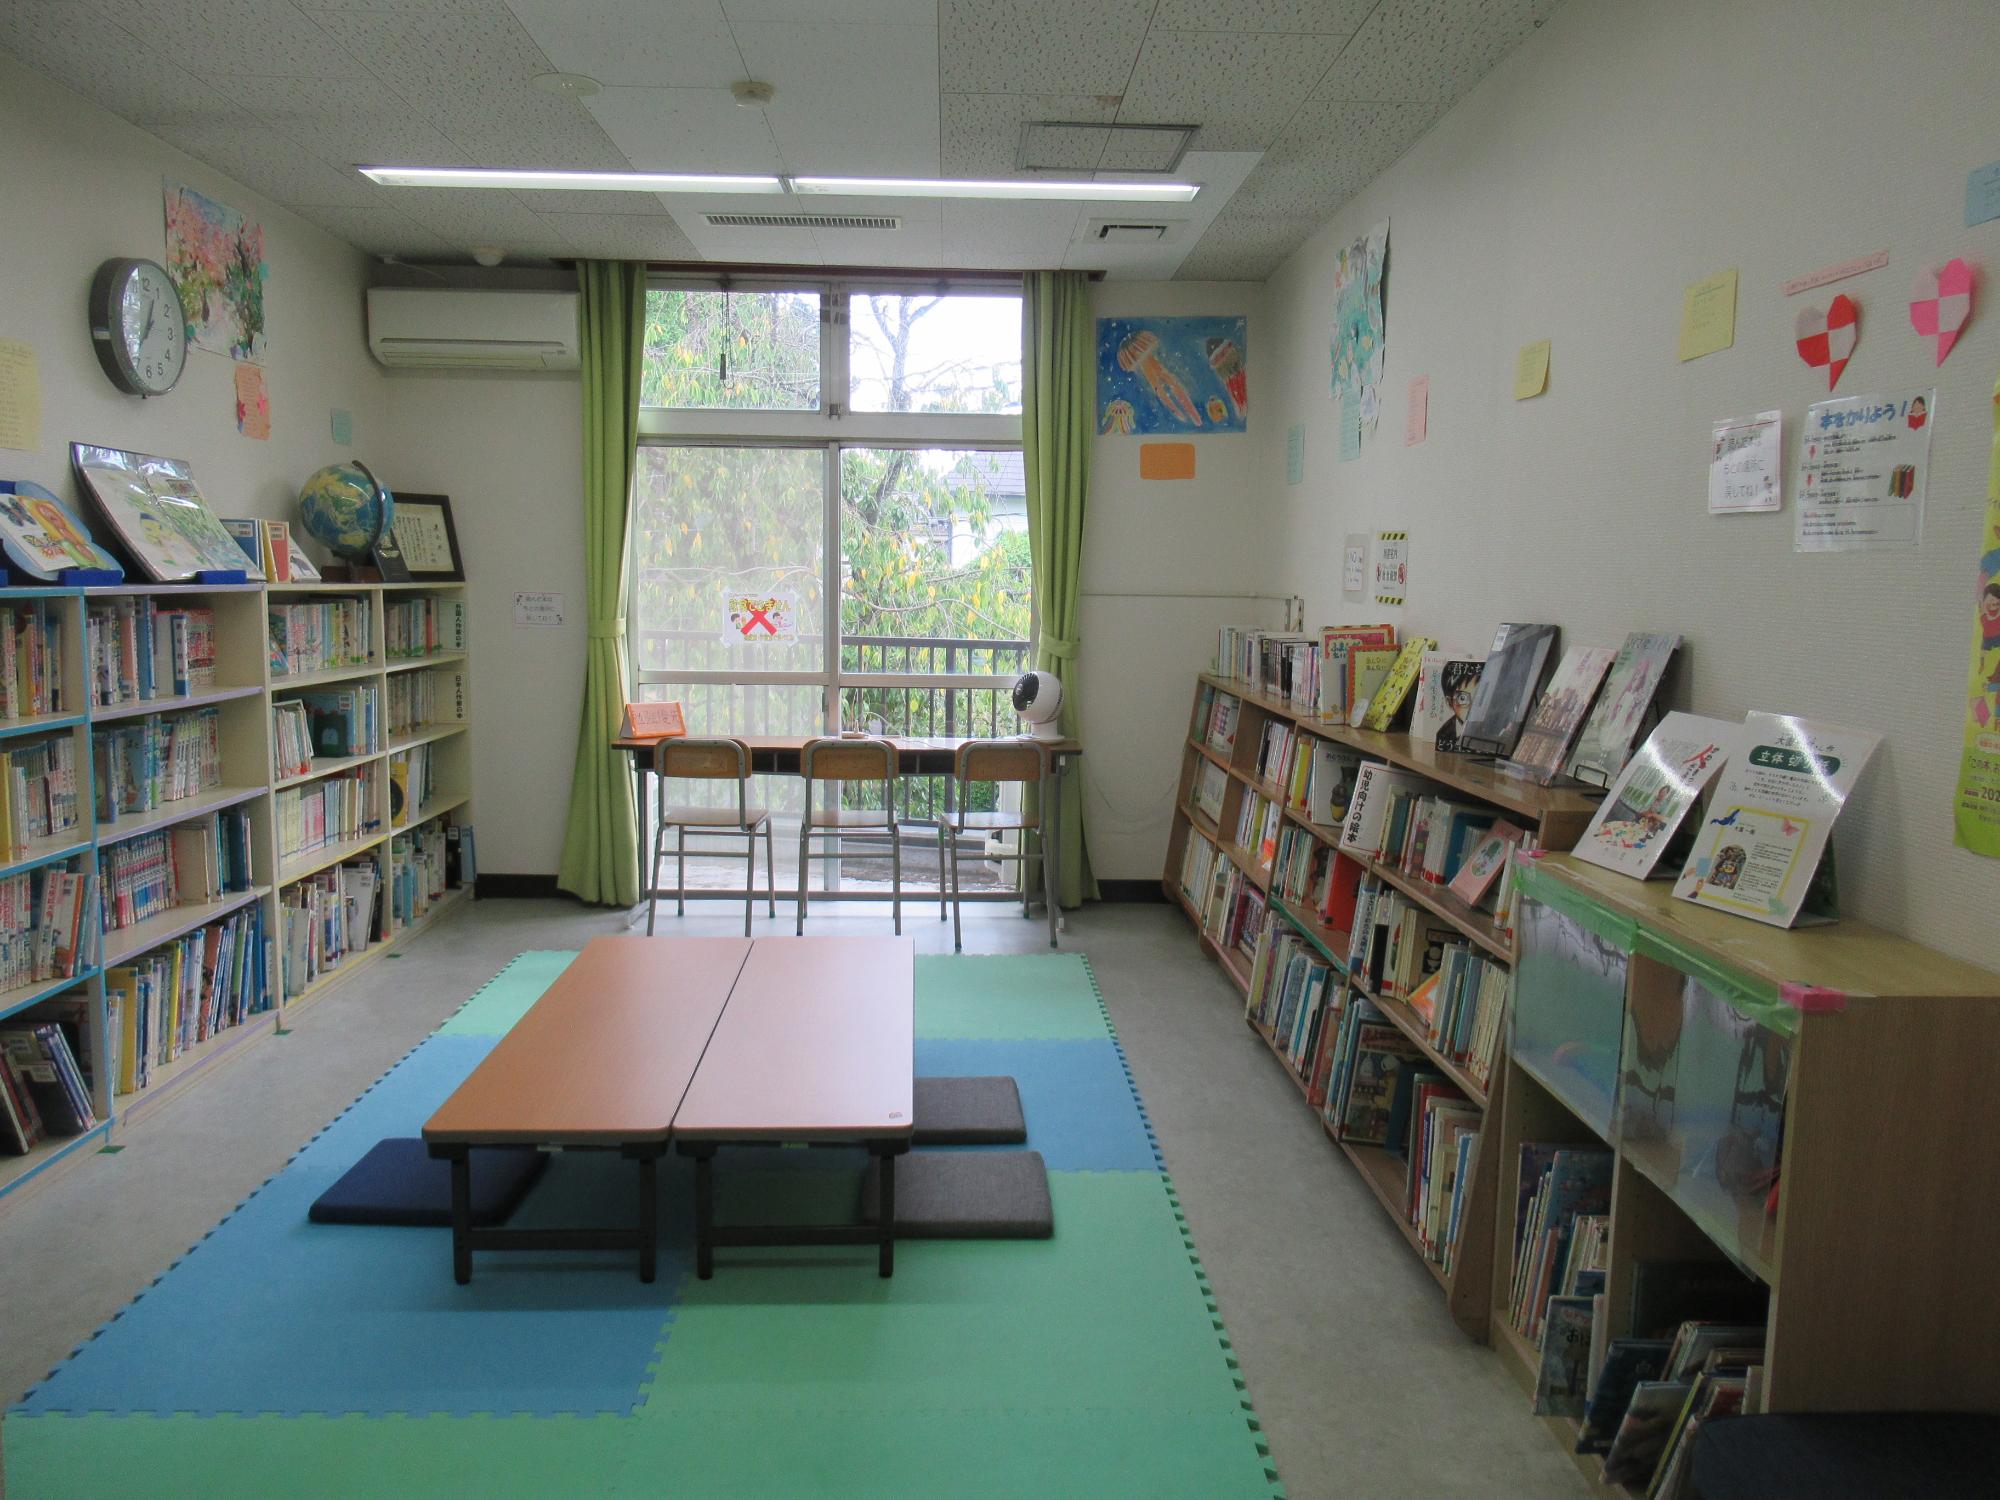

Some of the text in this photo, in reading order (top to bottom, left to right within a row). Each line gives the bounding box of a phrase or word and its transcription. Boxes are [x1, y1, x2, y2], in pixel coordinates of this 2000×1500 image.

[164, 304, 171, 317] 2
[168, 327, 174, 340] 3
[146, 365, 152, 378] 6
[158, 363, 163, 375] 5
[1347, 769, 1374, 843] 幼児向けの絵本
